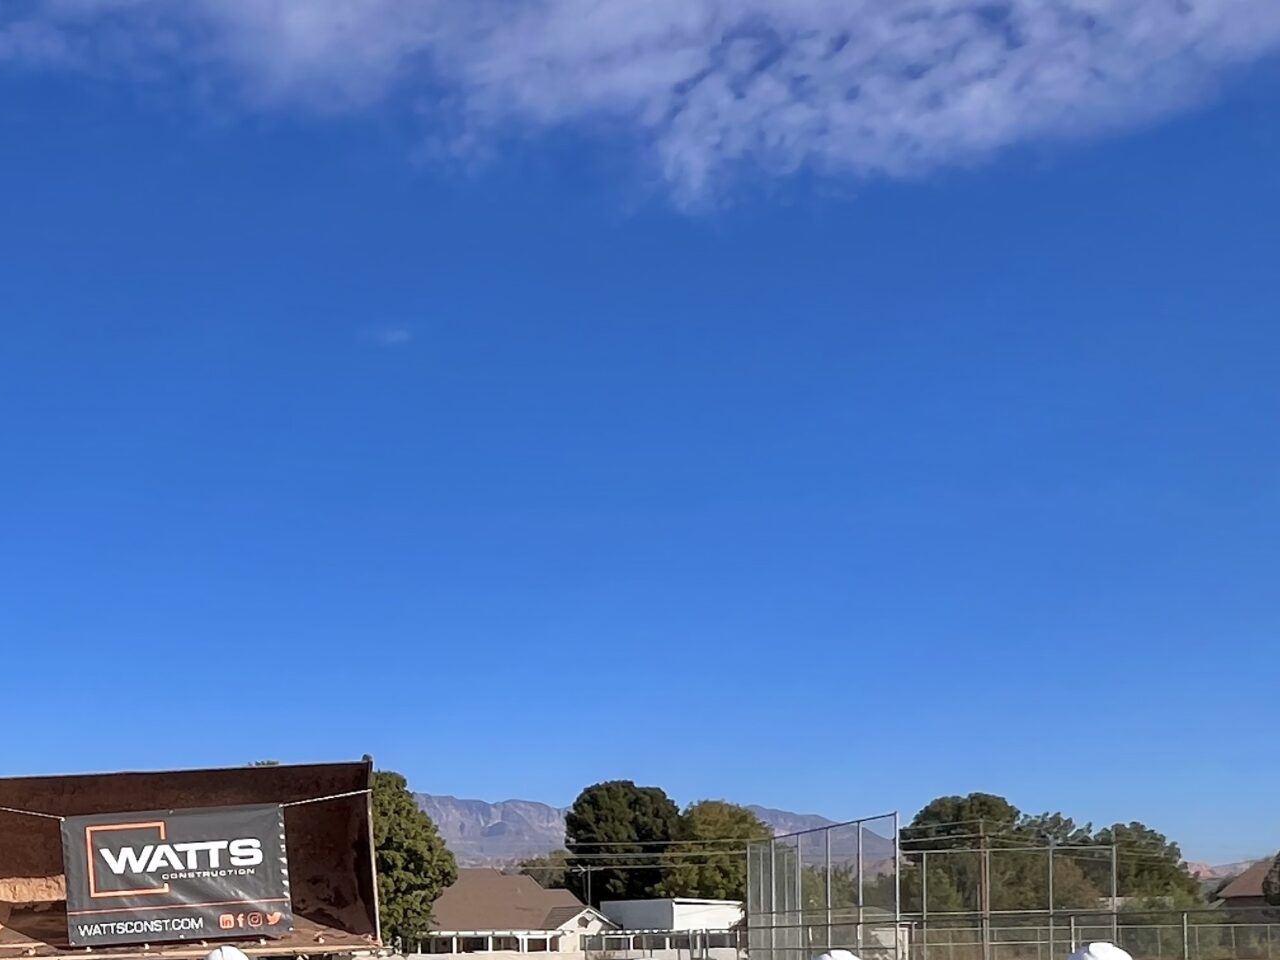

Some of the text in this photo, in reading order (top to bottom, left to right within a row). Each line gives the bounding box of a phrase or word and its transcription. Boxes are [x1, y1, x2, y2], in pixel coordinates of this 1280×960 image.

[99, 838, 263, 874] WATTS
[161, 868, 256, 880] CONSTRUCTION
[77, 916, 204, 937] WATTSCONST.COM
